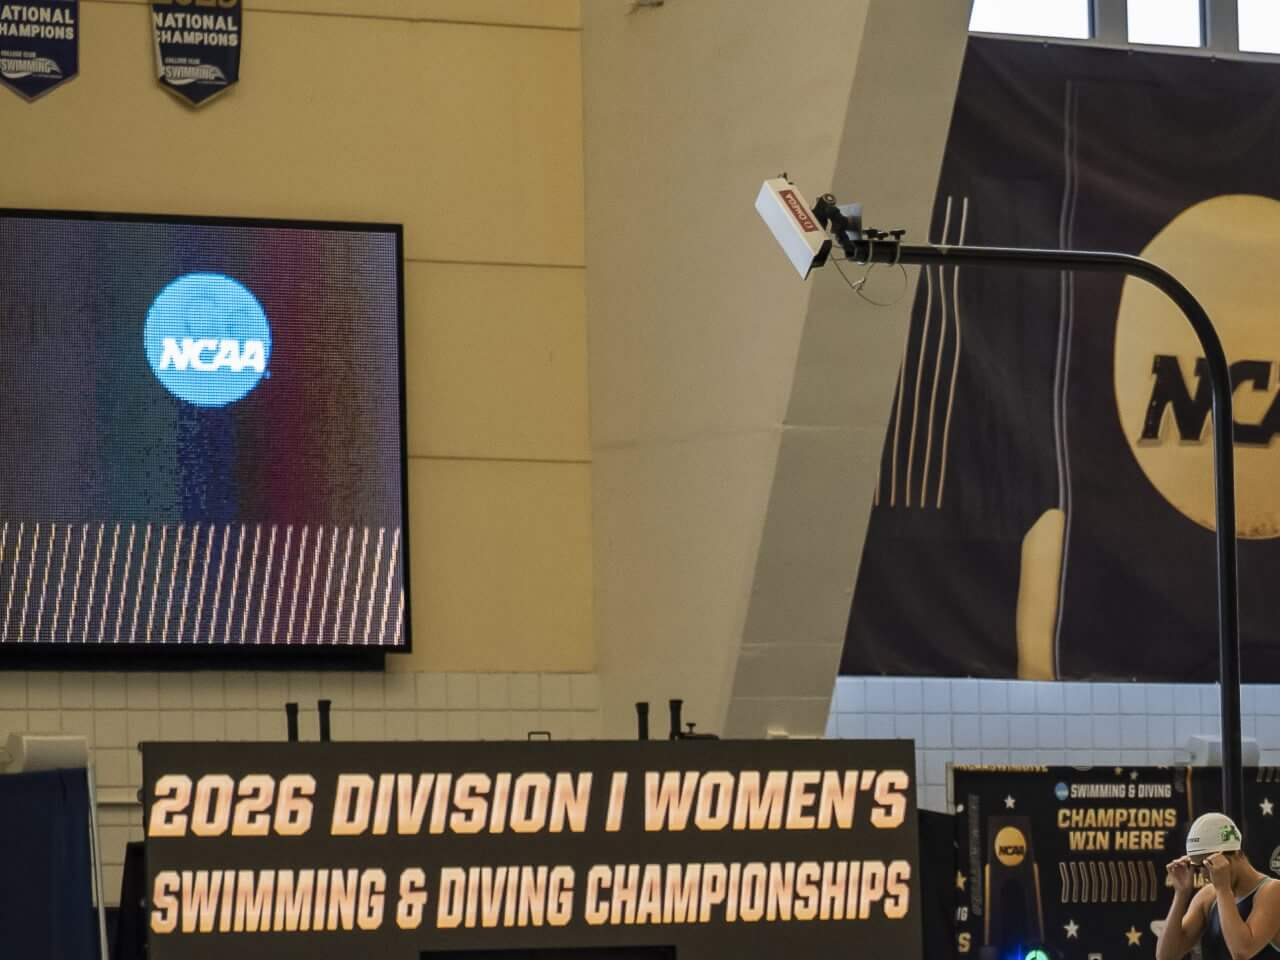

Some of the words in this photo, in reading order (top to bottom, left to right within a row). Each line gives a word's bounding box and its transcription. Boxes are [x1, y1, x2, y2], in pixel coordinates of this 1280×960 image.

[1, 5, 74, 24] ATIONAL
[153, 12, 238, 31] NATIONAL
[0, 22, 74, 40] HAMPIONS
[160, 337, 265, 373] NCAA
[1070, 783, 1126, 798] SWIMMING
[1128, 783, 1136, 798] &
[1138, 783, 1172, 798] DIVING
[148, 773, 317, 837] 2026
[330, 771, 593, 836] DIVISION
[605, 771, 629, 832] I
[645, 769, 910, 832] WOMEN'S
[1057, 808, 1177, 828] CHAMPIONS
[1069, 831, 1110, 850] WIN
[1115, 831, 1166, 850] HERE
[151, 867, 386, 934] SWIMMING
[396, 866, 428, 930] &
[437, 865, 575, 929] DIVING
[584, 859, 911, 926] CHAMPIONSHIPS
